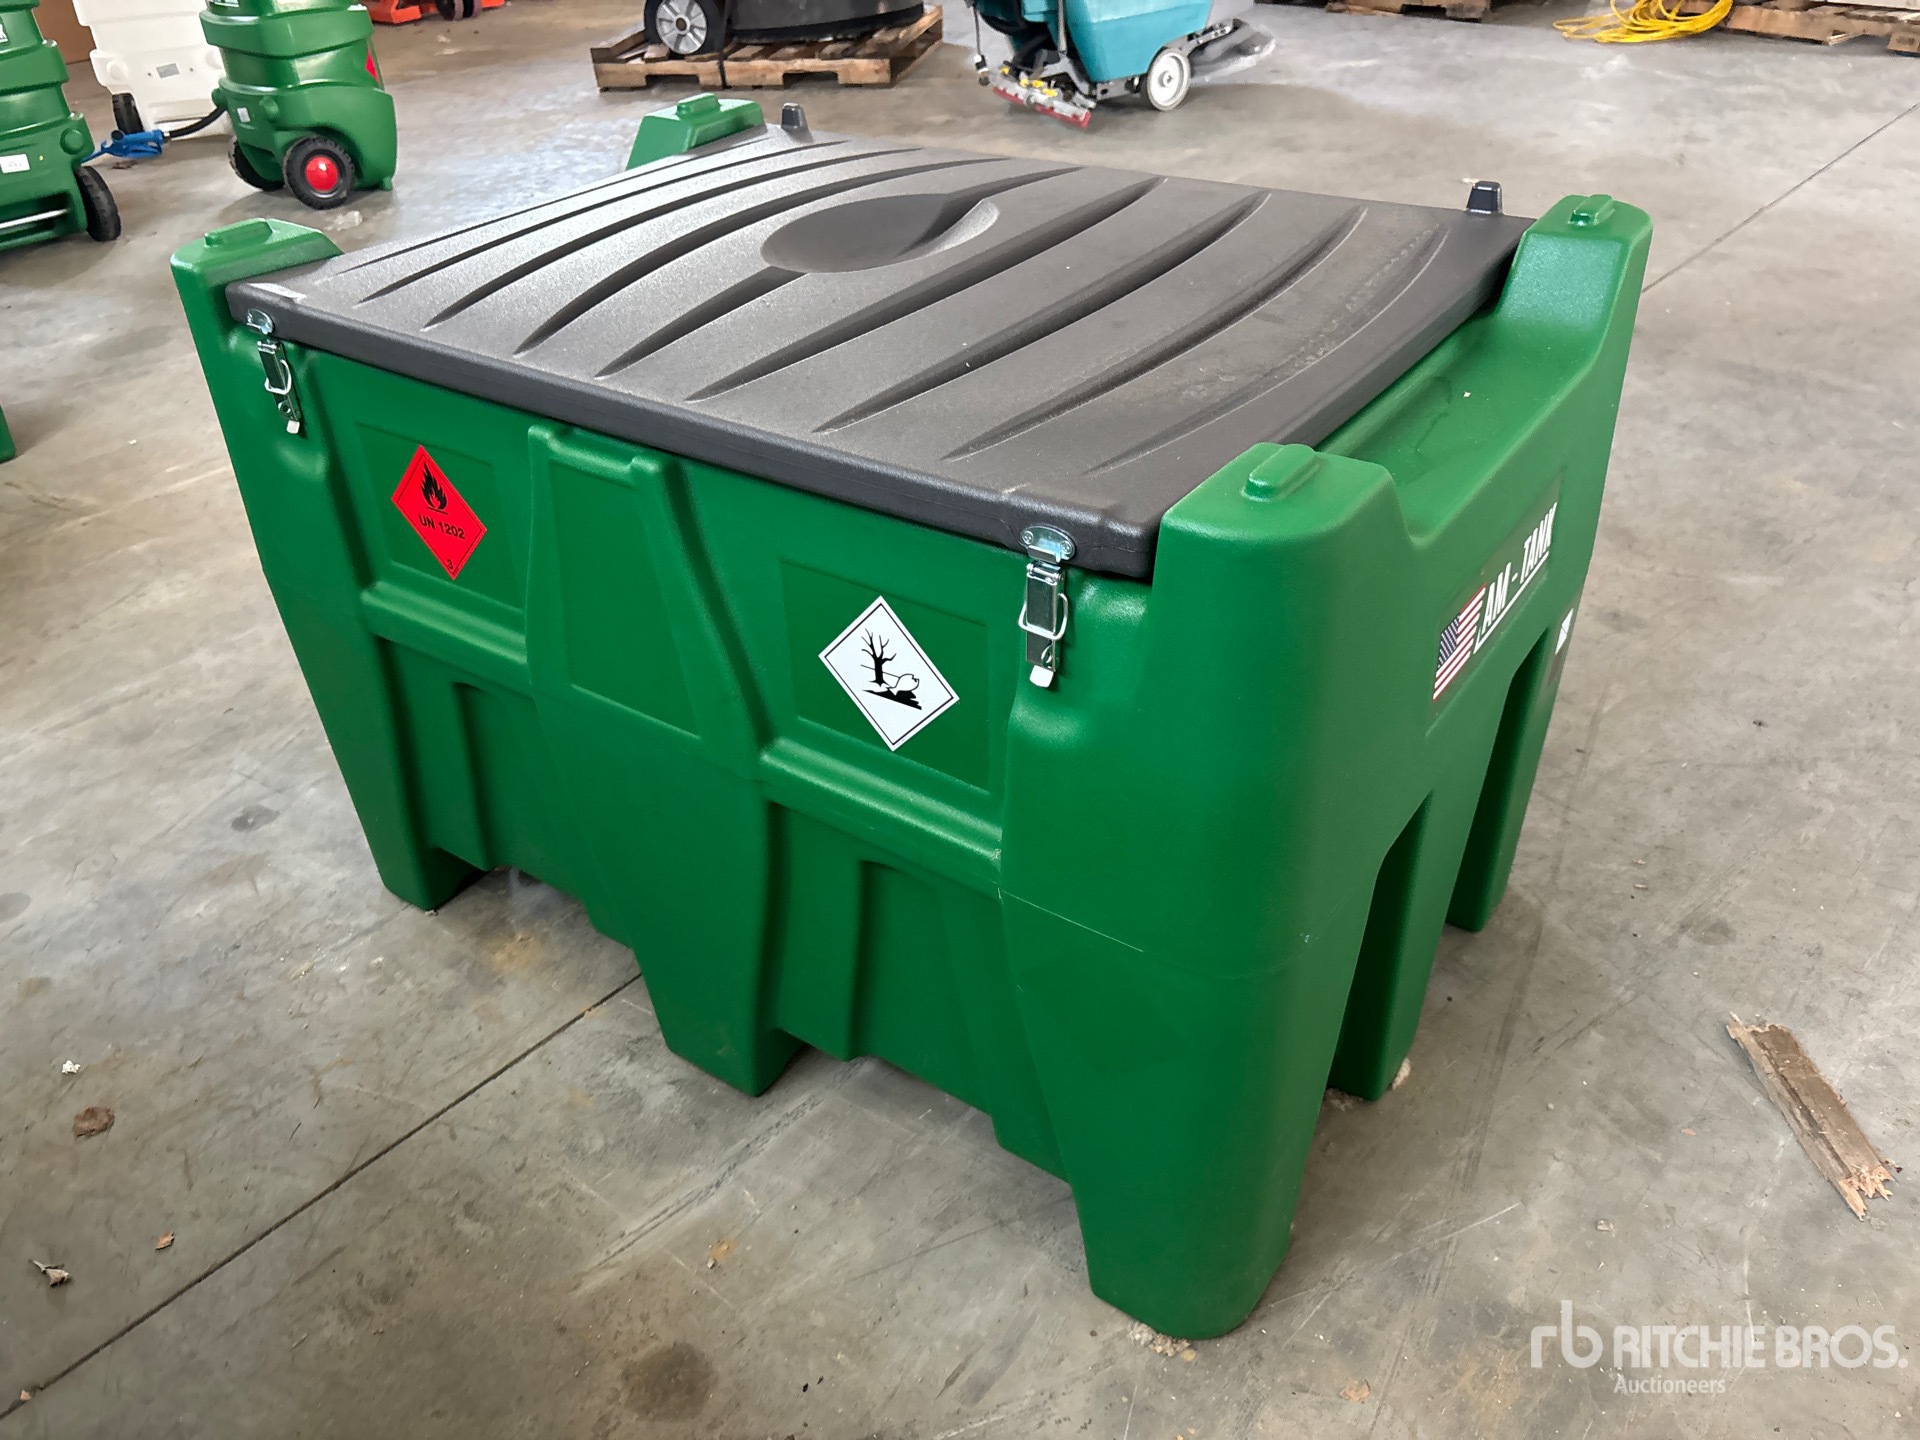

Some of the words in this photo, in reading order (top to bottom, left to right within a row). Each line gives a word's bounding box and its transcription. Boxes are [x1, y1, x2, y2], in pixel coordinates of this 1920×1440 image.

[418, 514, 435, 529] UN
[438, 521, 465, 540] 1202
[447, 559, 454, 569] 3
[1481, 562, 1511, 634] AM
